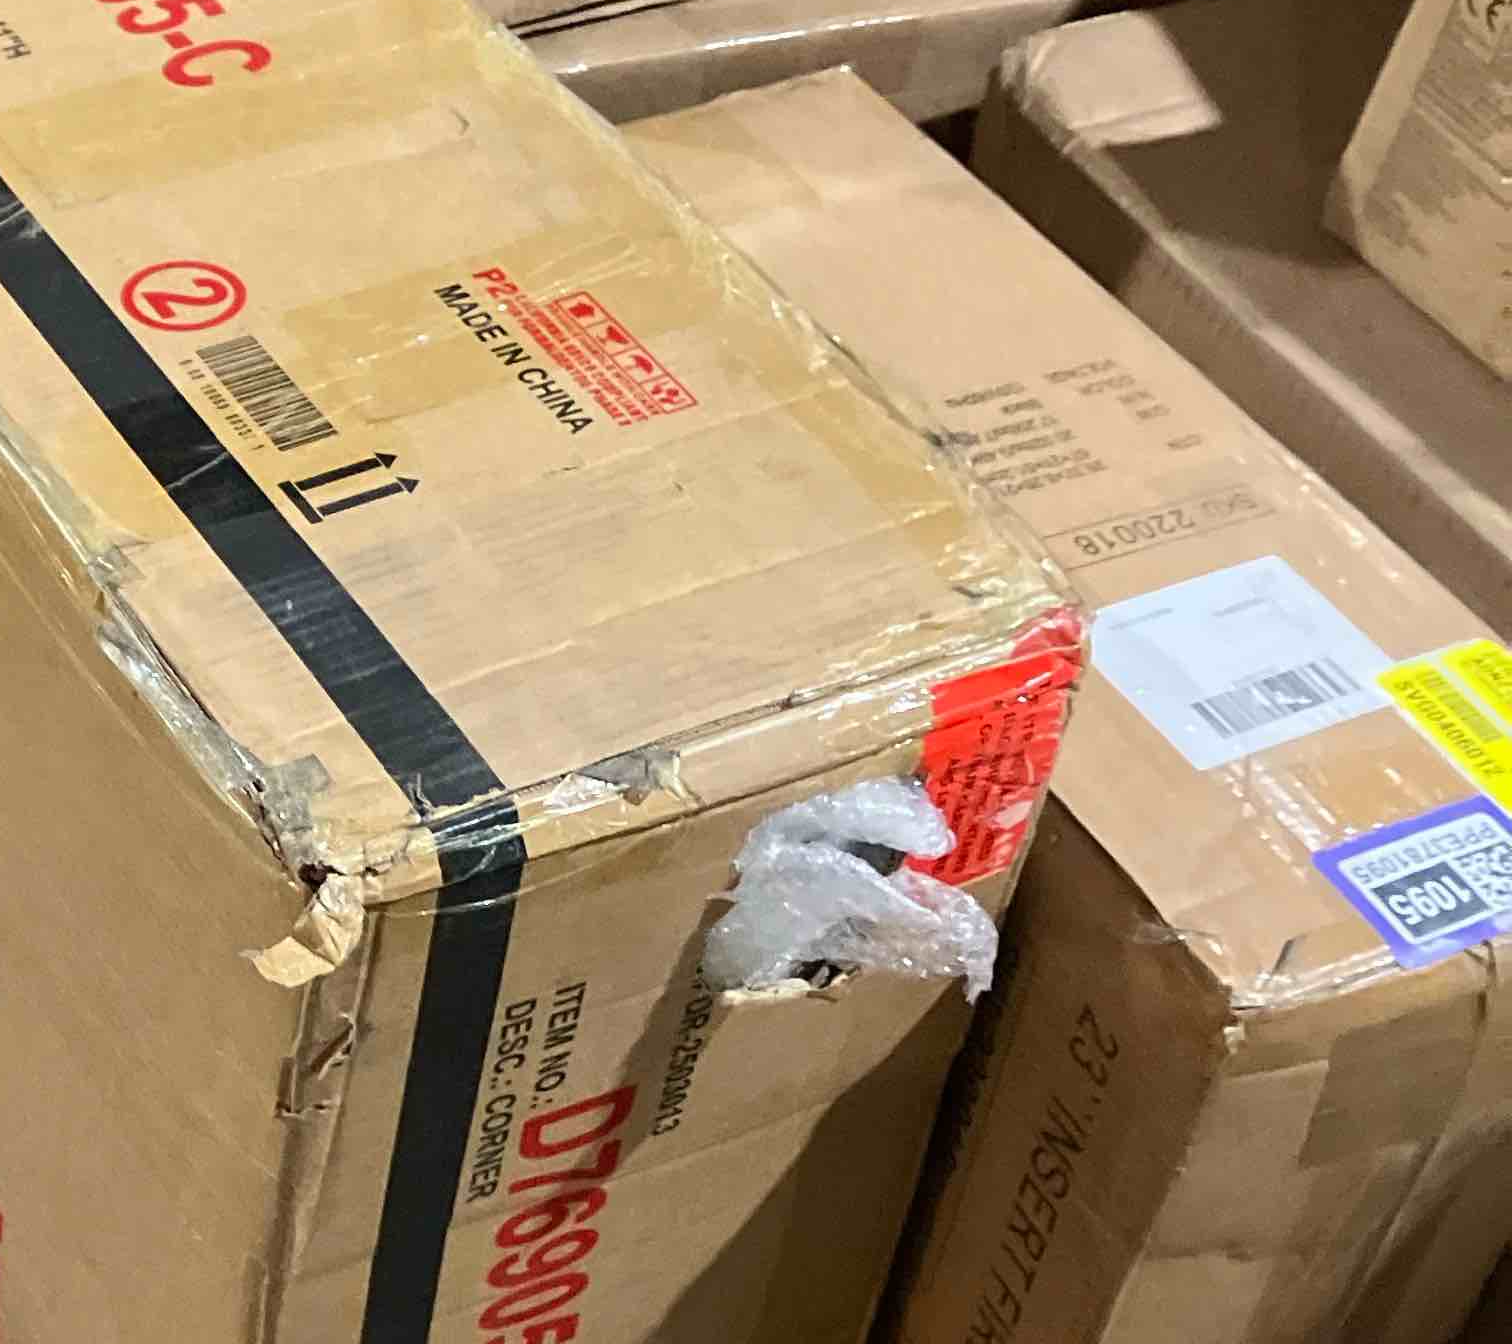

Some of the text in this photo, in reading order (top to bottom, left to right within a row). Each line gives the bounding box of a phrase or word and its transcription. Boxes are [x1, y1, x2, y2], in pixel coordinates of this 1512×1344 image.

[433, 283, 510, 344] MADE
[490, 342, 531, 367] IN
[517, 367, 594, 435] CHINA
[1072, 508, 1196, 556] 220018
[1387, 874, 1474, 926] 1095
[543, 980, 587, 1051] ITEM
[465, 1094, 518, 1204] CORNER
[999, 1095, 1087, 1294] INSERT
